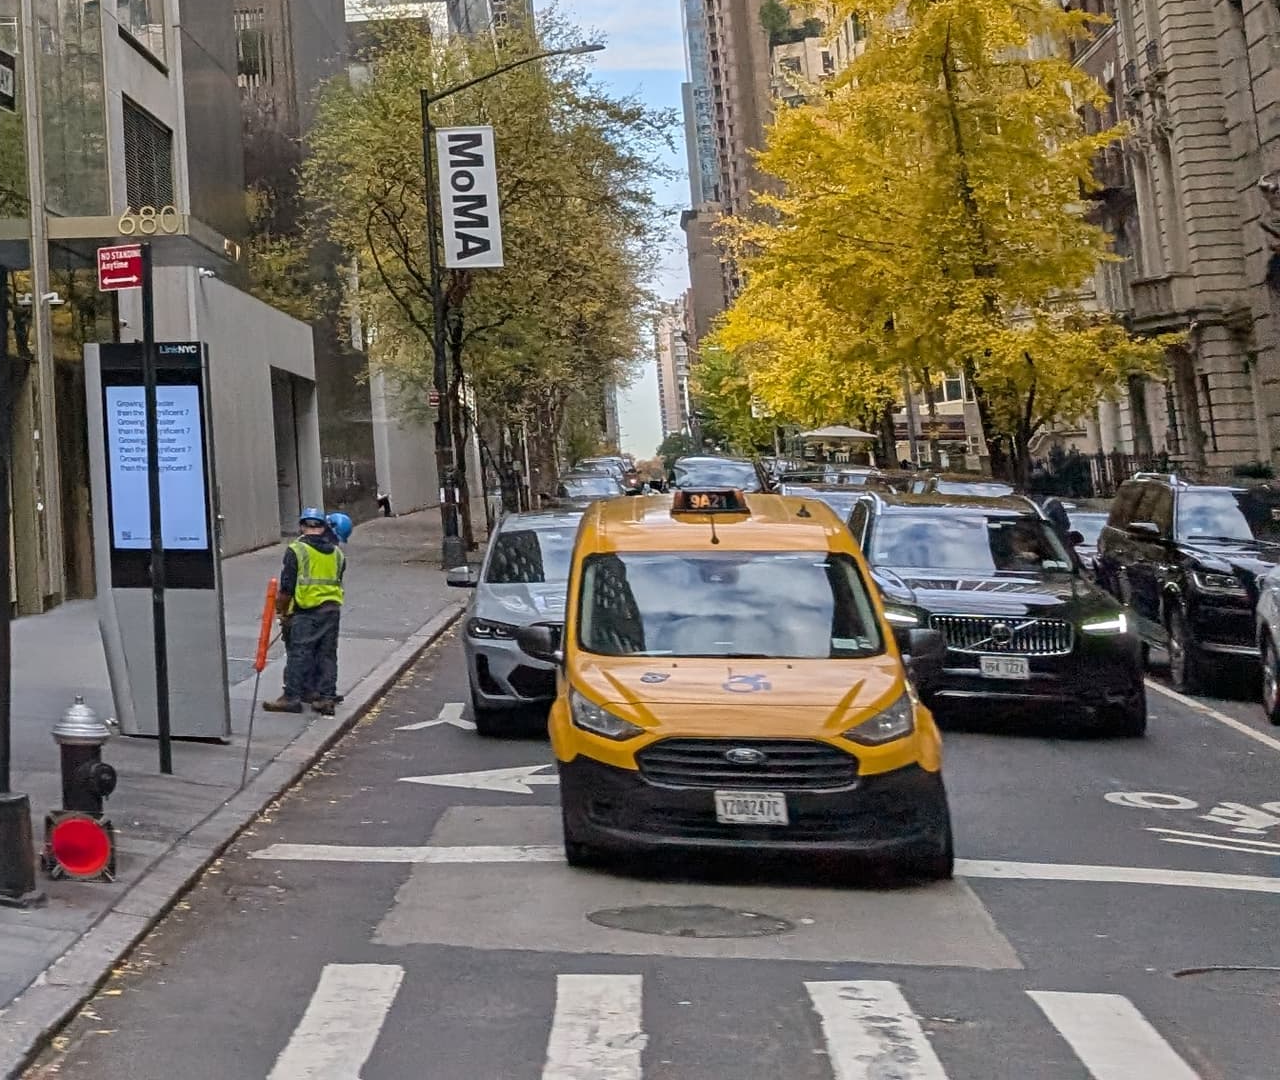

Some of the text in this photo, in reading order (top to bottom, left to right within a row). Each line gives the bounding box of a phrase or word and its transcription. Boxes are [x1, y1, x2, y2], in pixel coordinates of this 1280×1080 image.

[447, 133, 491, 261] MoMA
[118, 206, 179, 235] 680
[101, 252, 110, 260] NO
[102, 260, 129, 271] Anytime
[159, 345, 198, 354] LinkNYC
